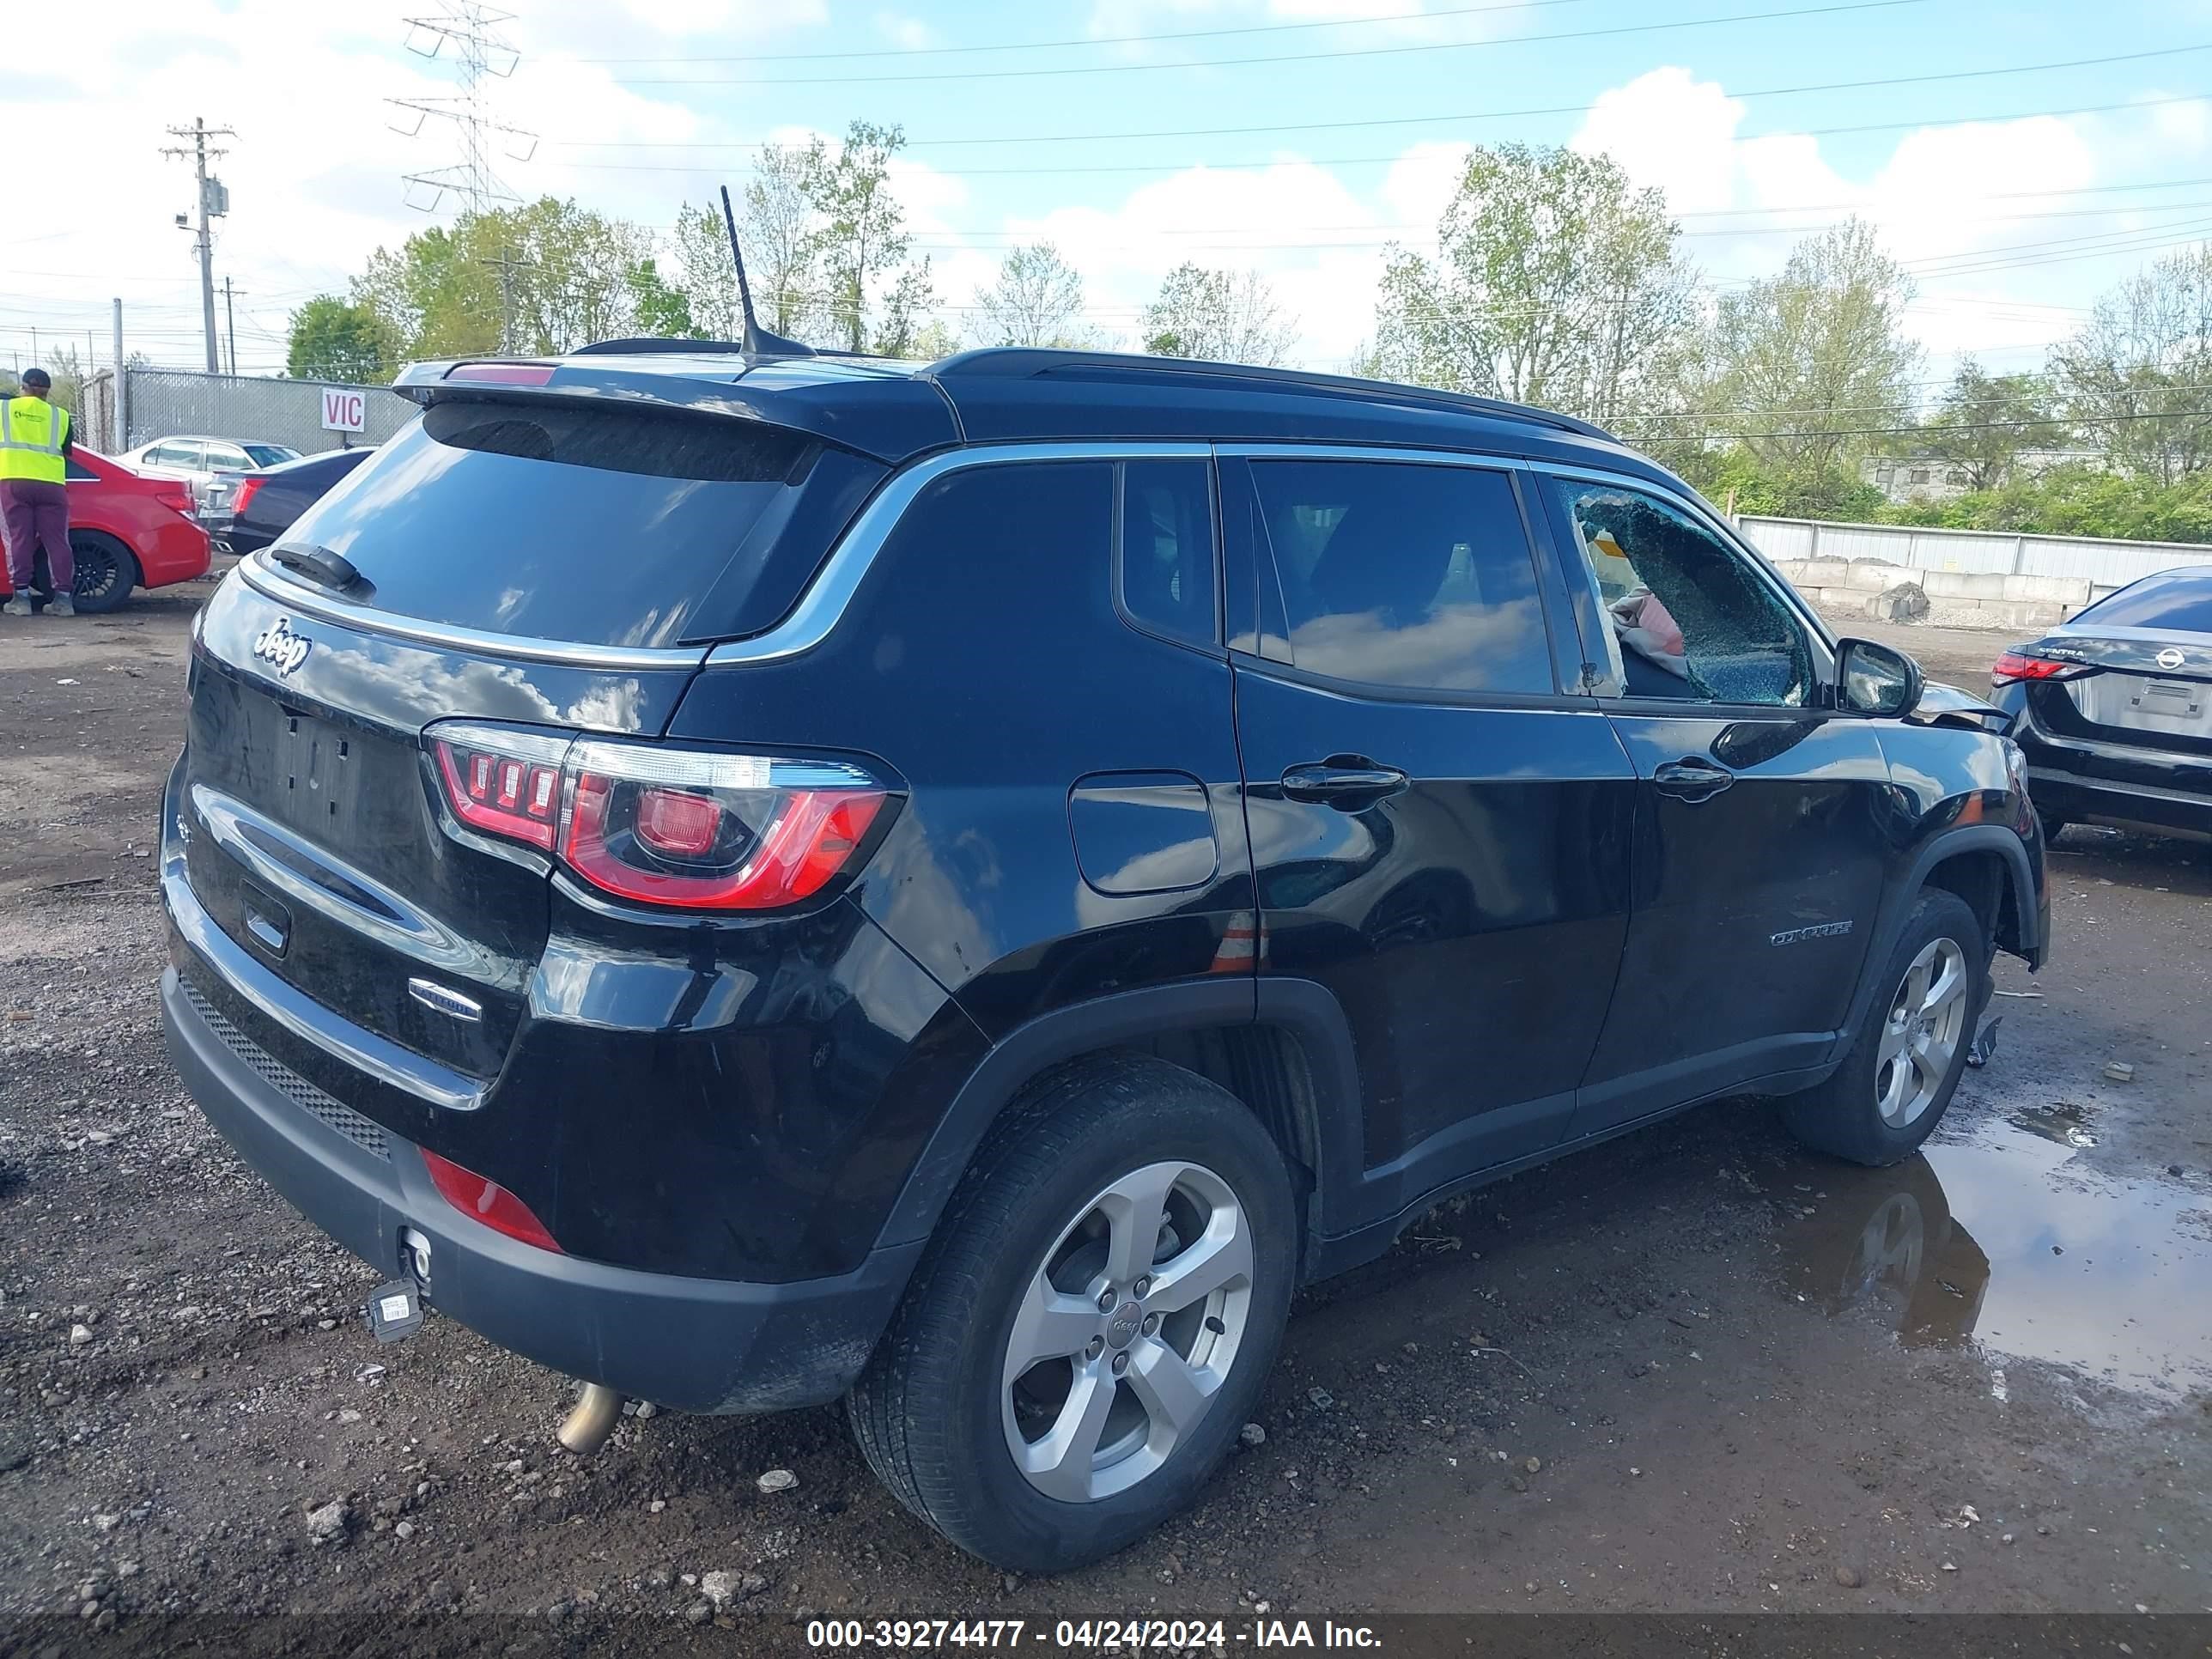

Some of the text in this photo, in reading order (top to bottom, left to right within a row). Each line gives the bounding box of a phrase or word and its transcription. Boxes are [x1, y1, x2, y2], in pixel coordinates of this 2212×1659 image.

[325, 393, 362, 427] VIC
[253, 617, 313, 678] Jeep
[2038, 647, 2086, 658] SENTRA
[1771, 921, 1854, 946] COMPASS
